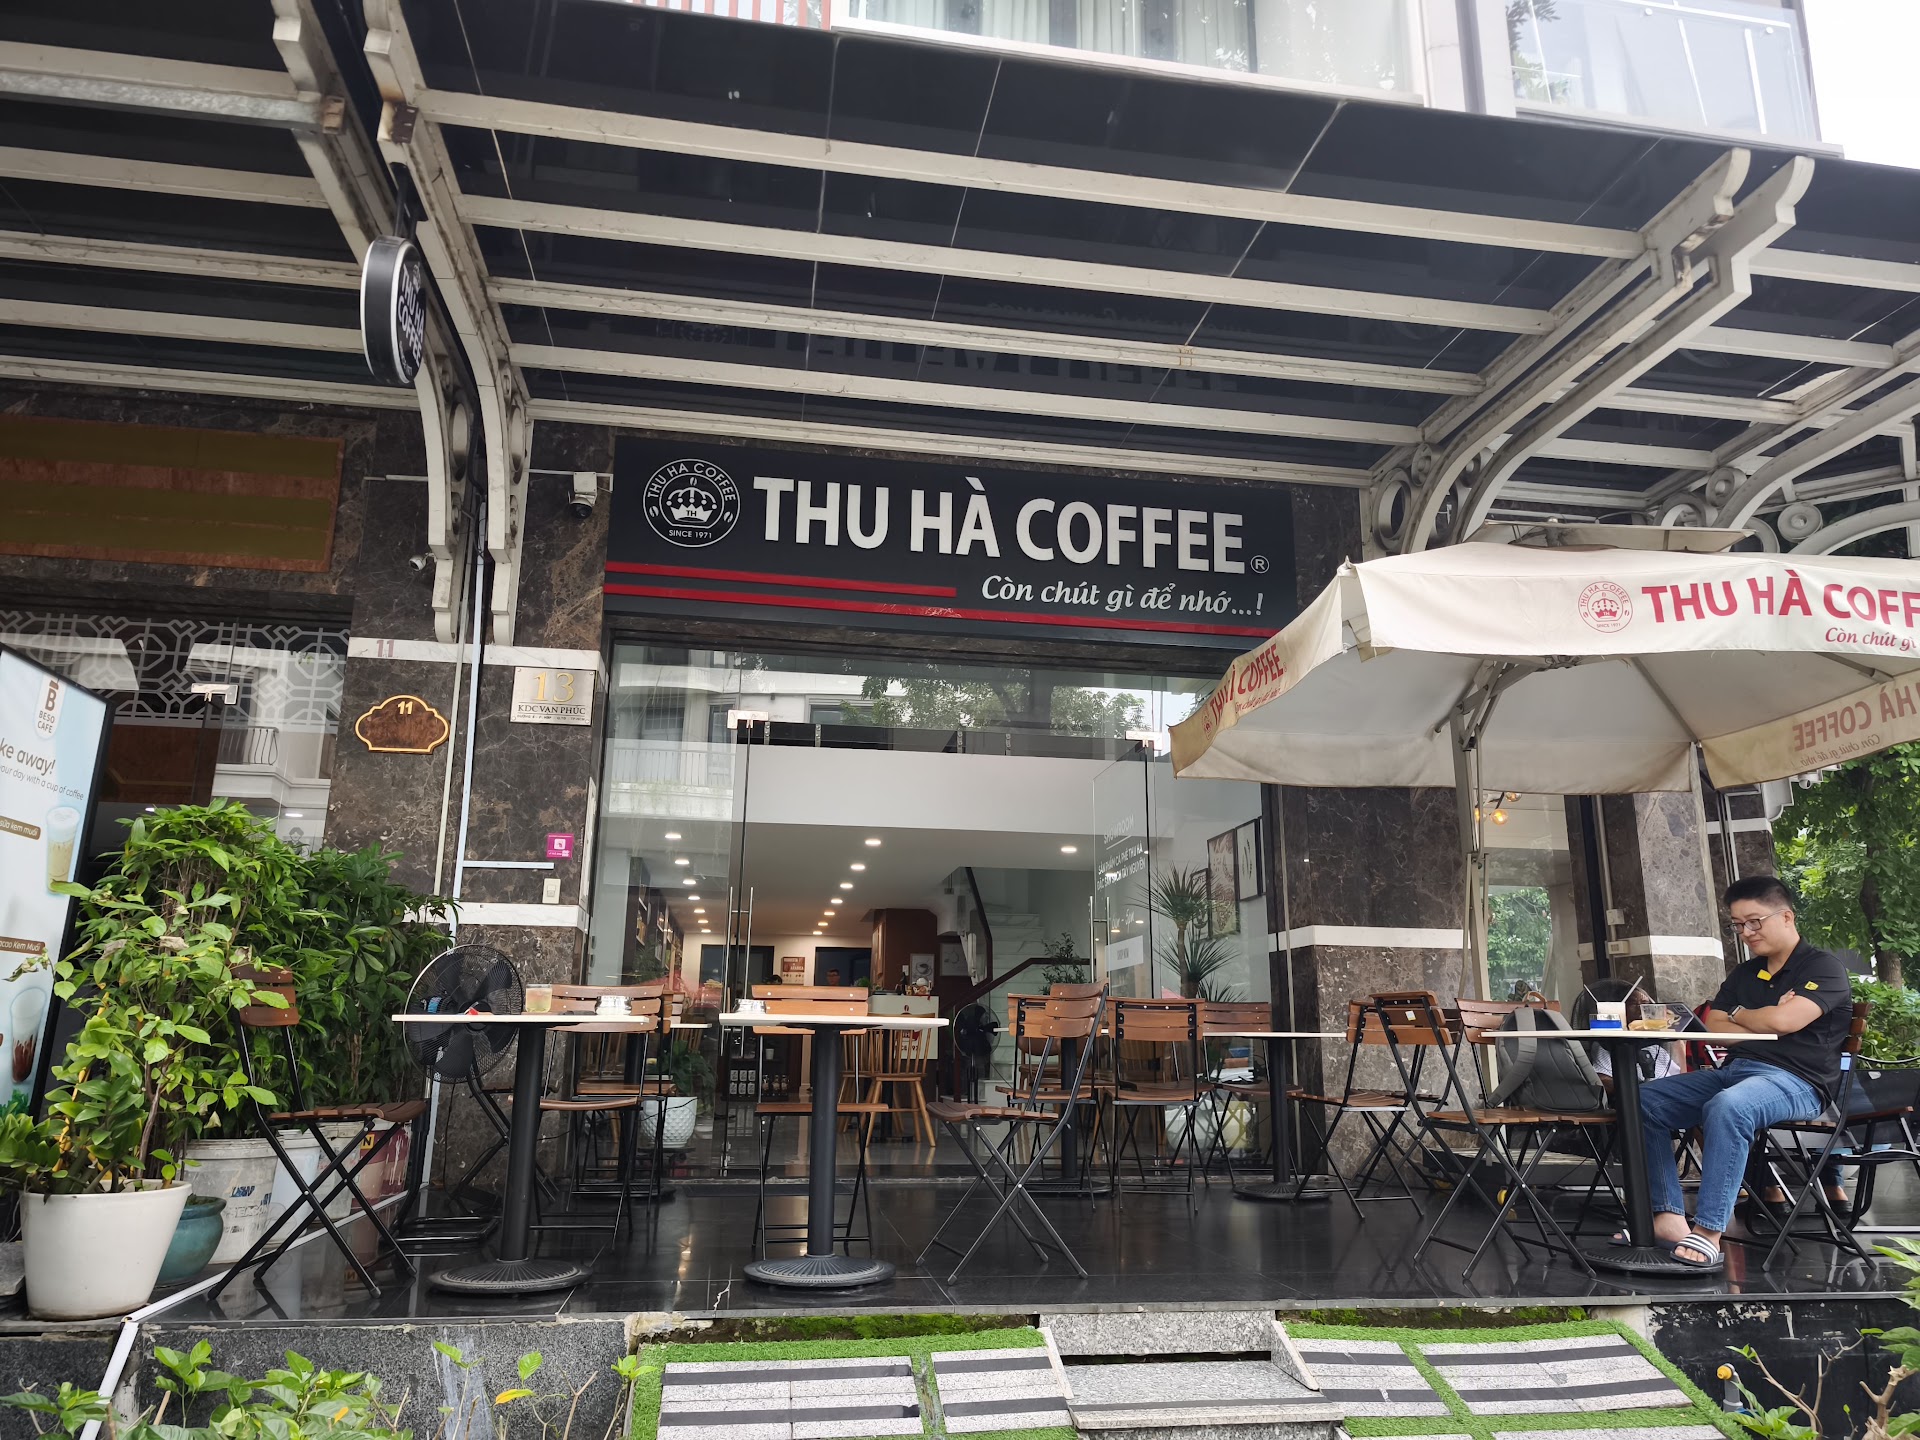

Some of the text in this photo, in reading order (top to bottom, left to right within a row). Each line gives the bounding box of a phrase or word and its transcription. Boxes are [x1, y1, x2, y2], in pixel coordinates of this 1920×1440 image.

[400, 263, 416, 315] THU
[398, 295, 423, 367] COFFEE
[647, 463, 736, 501] THU HA COFFEE
[669, 529, 712, 539] SINCE 1971
[753, 476, 889, 549] THU
[910, 476, 1001, 558] HÀ
[1016, 498, 1246, 574] COFFEE
[981, 575, 1034, 602] Còn
[1040, 580, 1101, 605] chút
[1105, 583, 1135, 613] gì
[1140, 582, 1176, 610] để
[1580, 593, 1590, 608] THU
[1602, 583, 1629, 604] COFFEE
[1641, 581, 1738, 623] THU
[1746, 569, 1813, 617] HÀ
[376, 640, 394, 658] 11
[1825, 627, 1917, 652] Còn chút gì
[1237, 643, 1284, 695] COFFEE
[532, 671, 575, 703] 13
[39, 710, 55, 724] BESO
[397, 701, 413, 715] 11
[518, 704, 586, 715] KDC VẠN PHÚC
[37, 720, 53, 733] CAFE
[16, 751, 56, 777] away!
[0, 764, 85, 801] our day with a cup of coffee
[10, 821, 23, 833] kem
[1104, 813, 1134, 845] SHOWROOM
[13, 940, 26, 950] Kem
